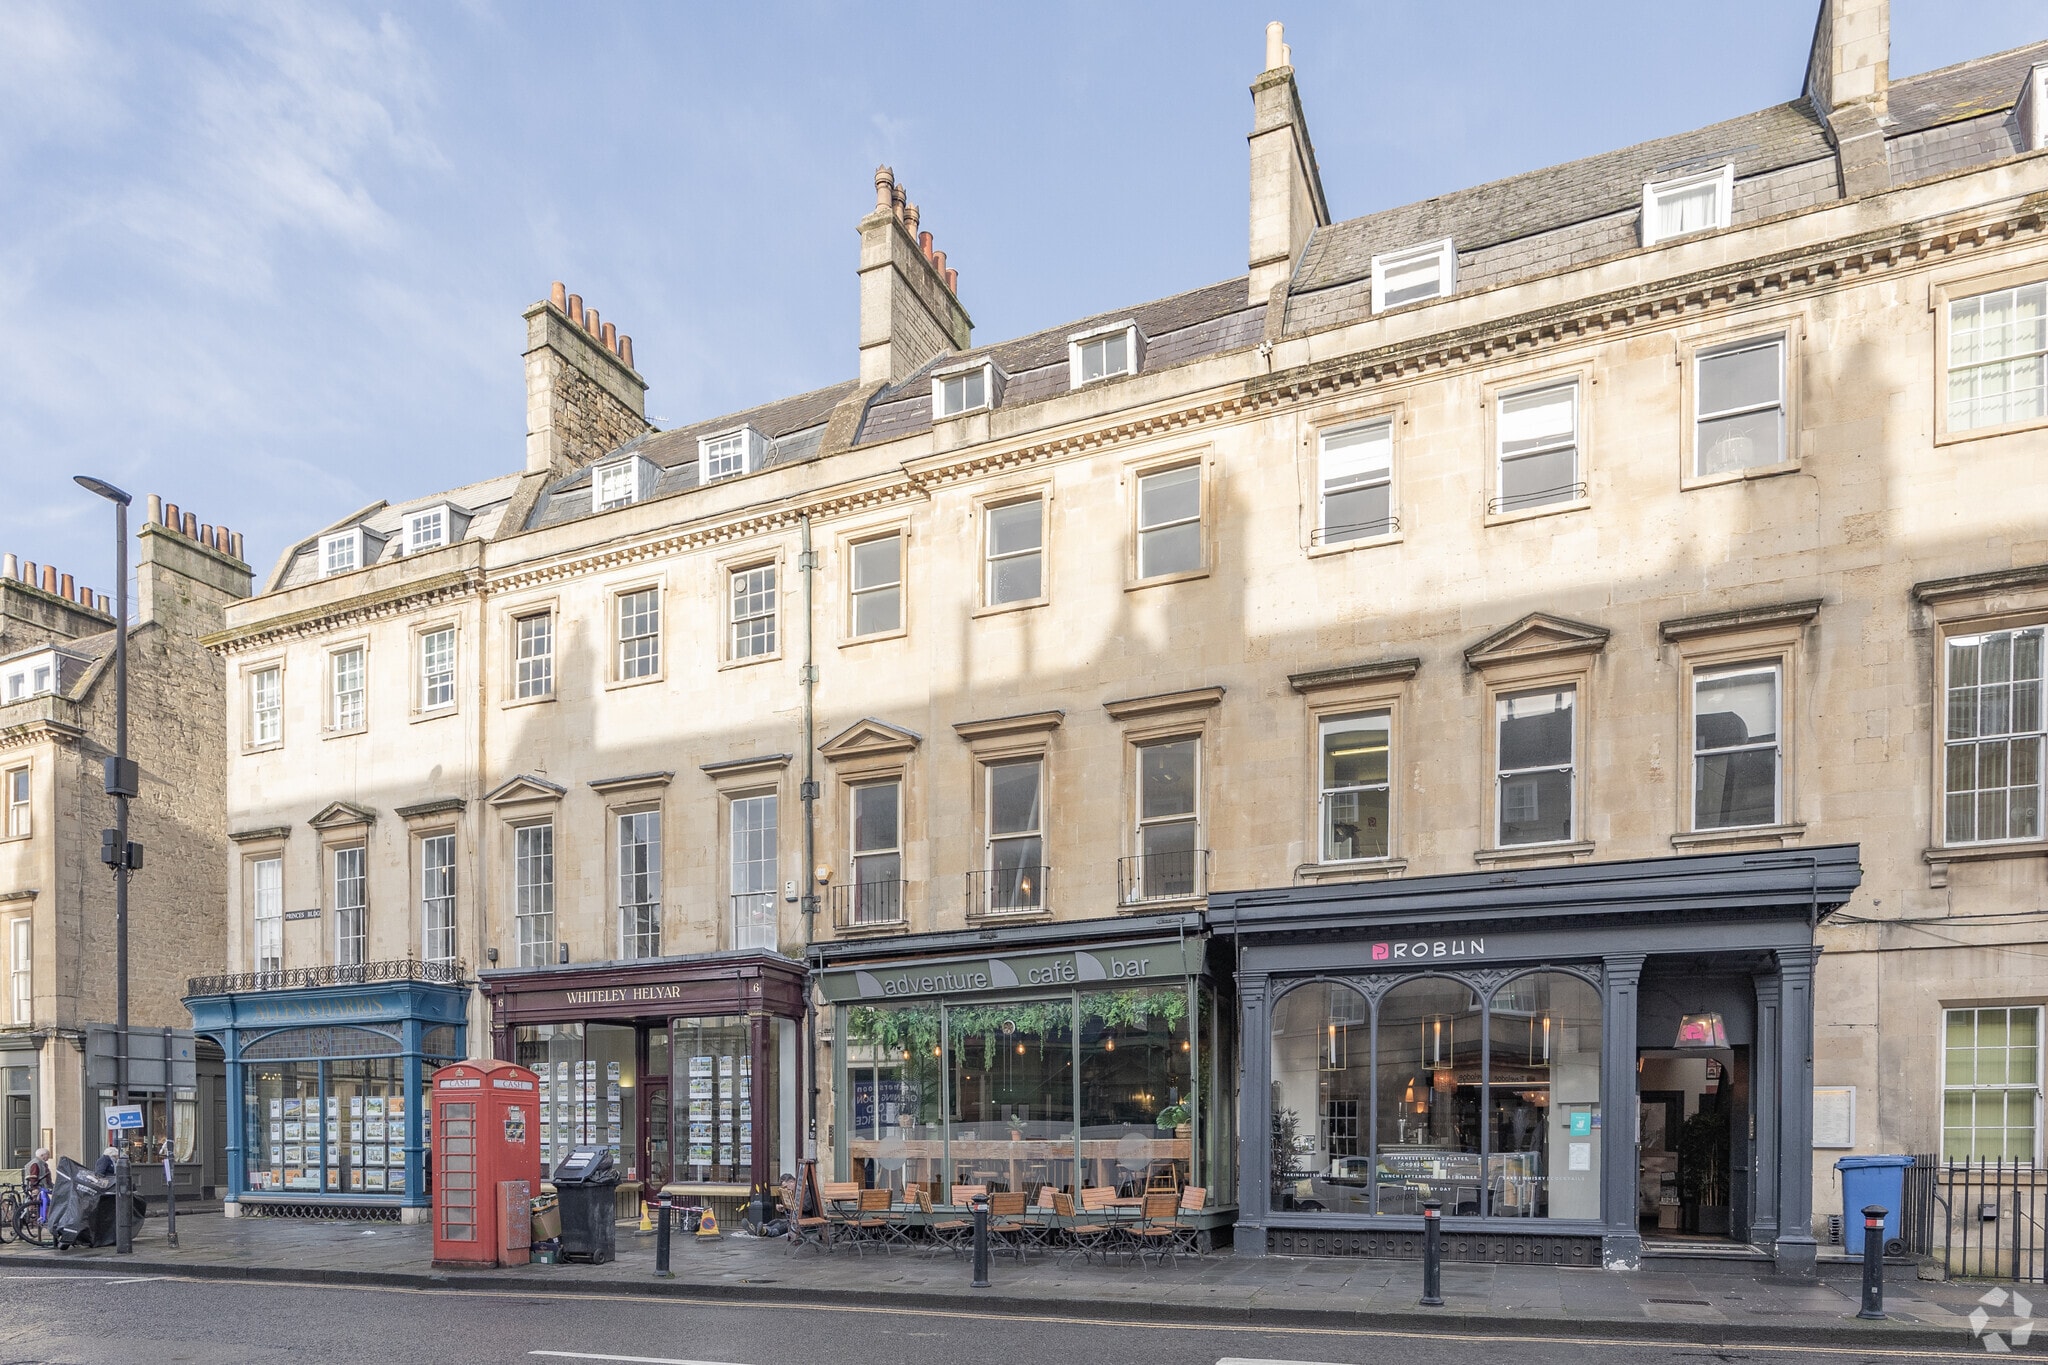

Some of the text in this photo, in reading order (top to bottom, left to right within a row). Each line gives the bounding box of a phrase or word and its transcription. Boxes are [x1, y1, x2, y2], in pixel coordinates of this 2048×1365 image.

[286, 911, 305, 920] PRINCES
[1393, 938, 1485, 959] ROBUN
[884, 956, 1150, 996] adventure café bar
[752, 982, 760, 993] 6
[566, 985, 681, 1005] WHITELEY HELYAR
[254, 994, 384, 1021] ALLEN & HARRIS
[498, 998, 504, 1008] 6
[449, 1079, 470, 1087] CASH
[502, 1080, 523, 1089] CASH
